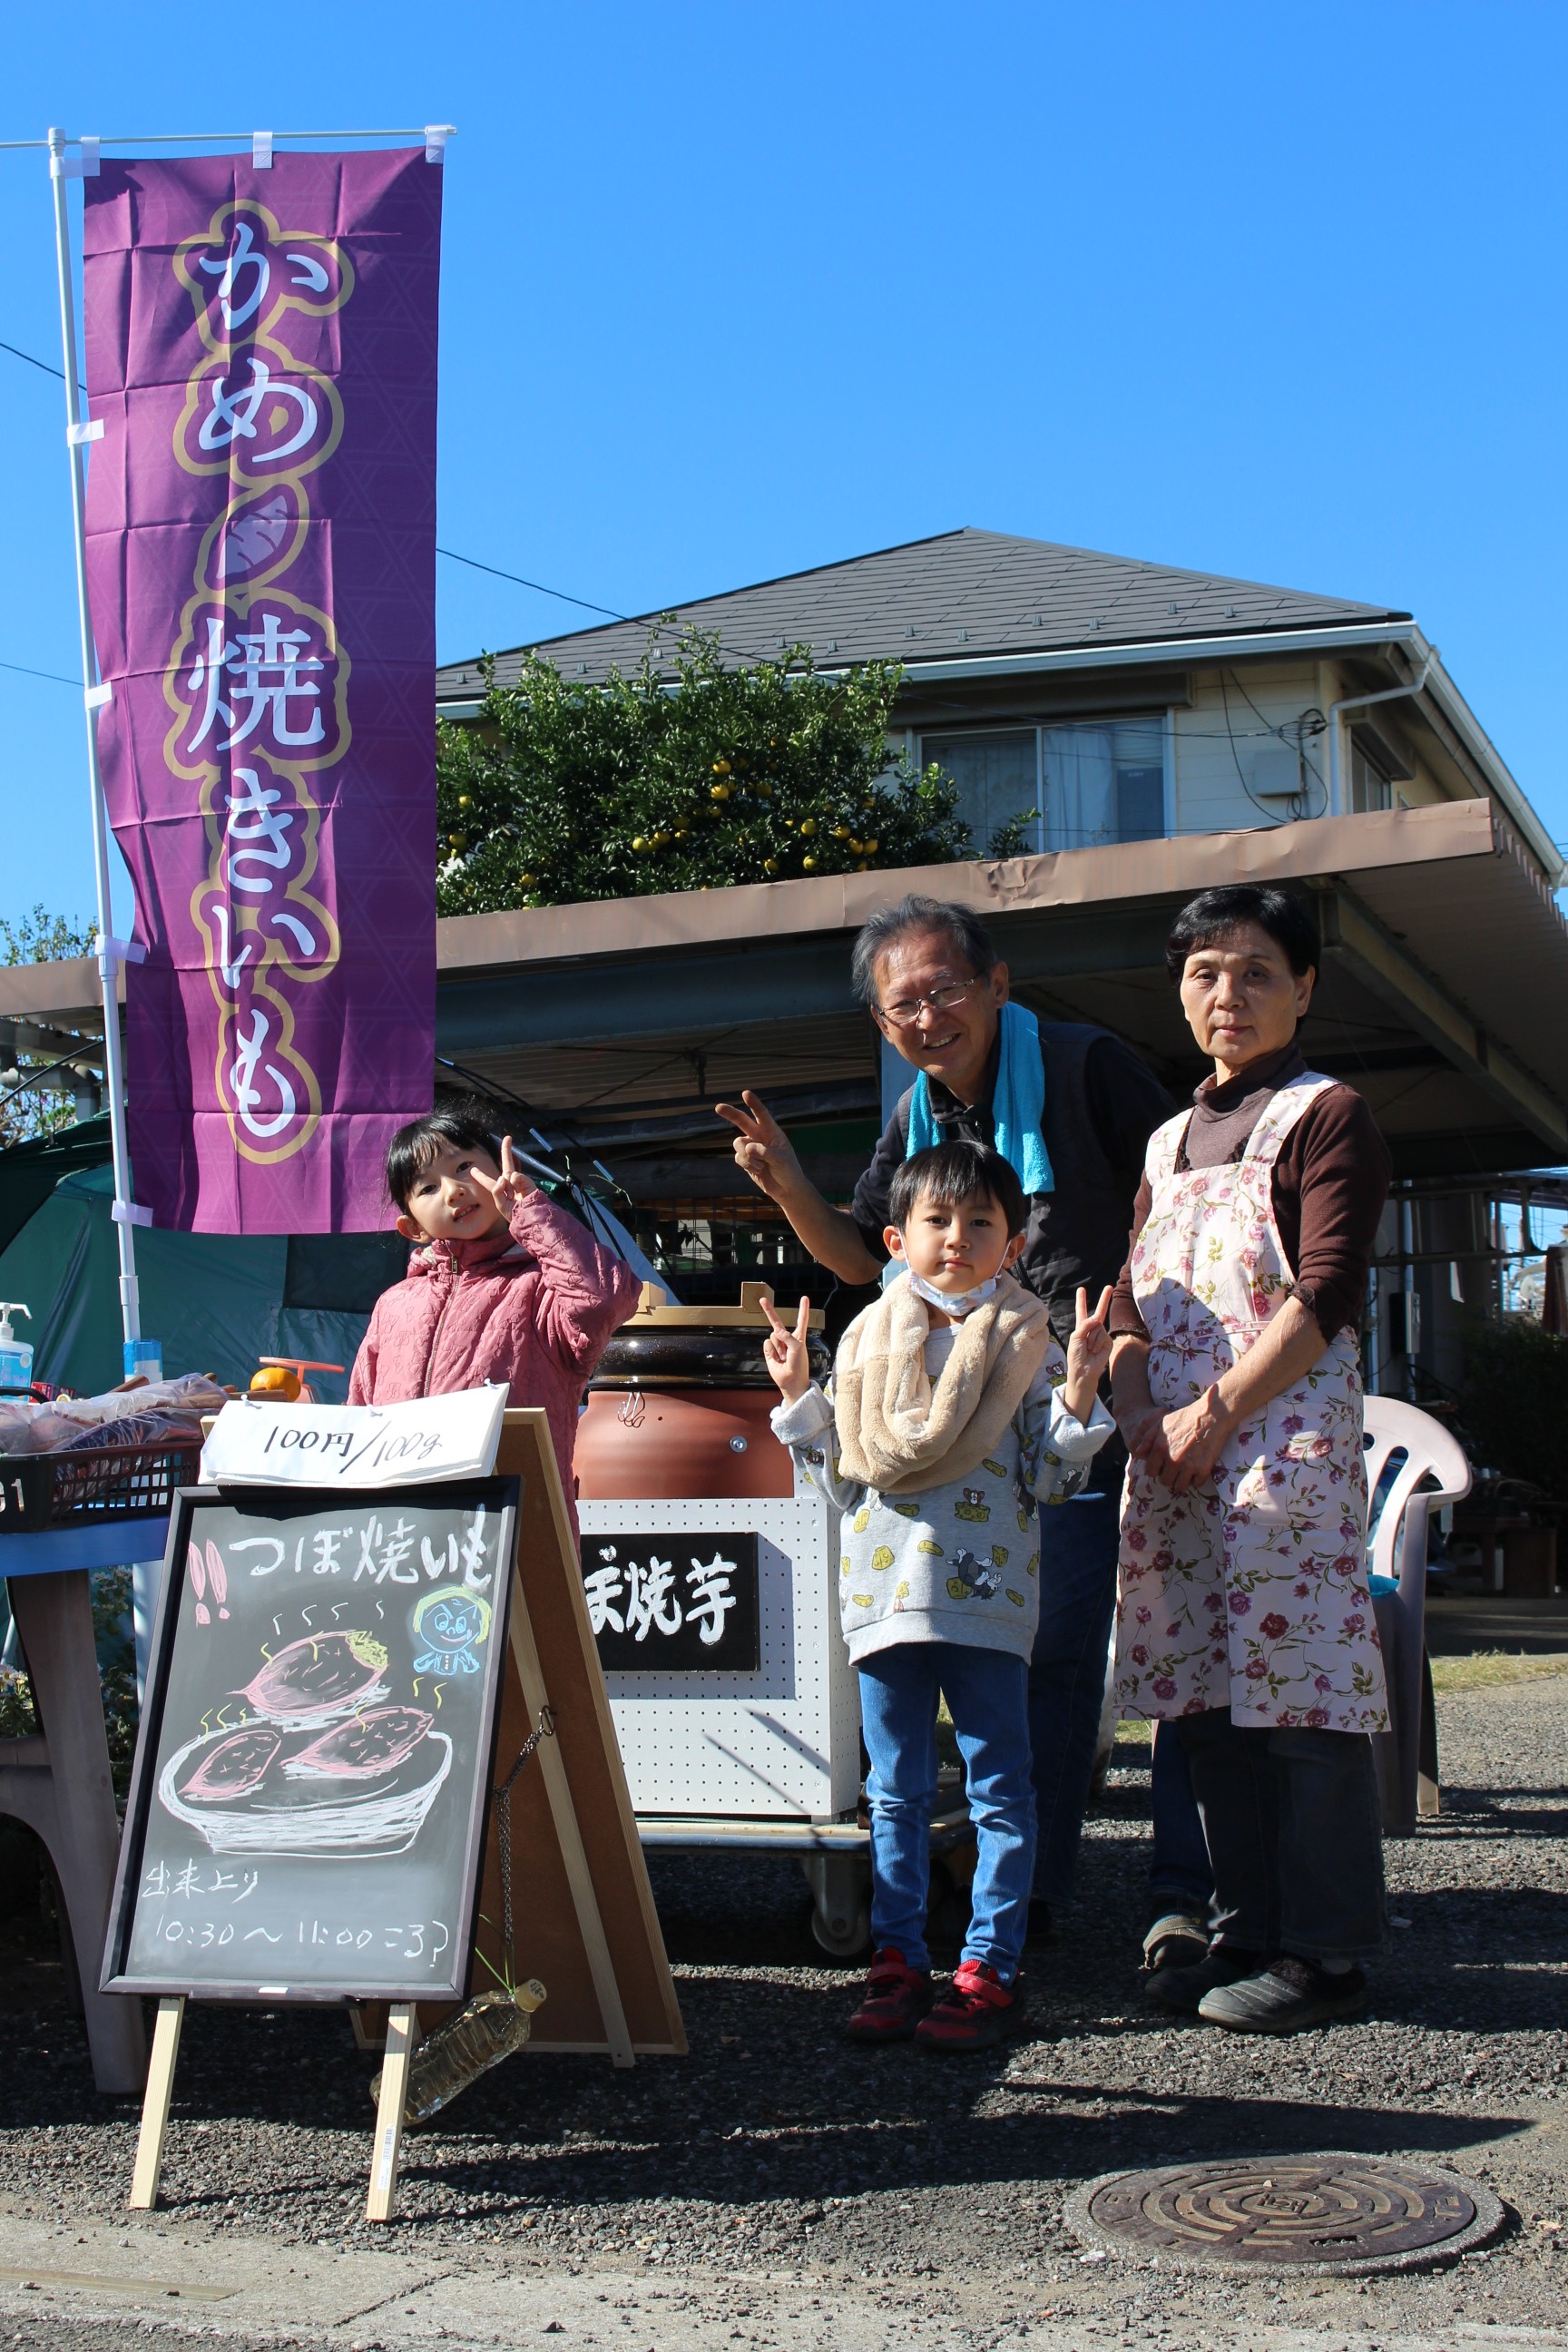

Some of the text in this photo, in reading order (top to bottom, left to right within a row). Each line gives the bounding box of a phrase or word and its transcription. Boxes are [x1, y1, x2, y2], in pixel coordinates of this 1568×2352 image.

[229, 1504, 492, 1588] つぼ焼いも
[142, 1857, 259, 1904] 出来上り
